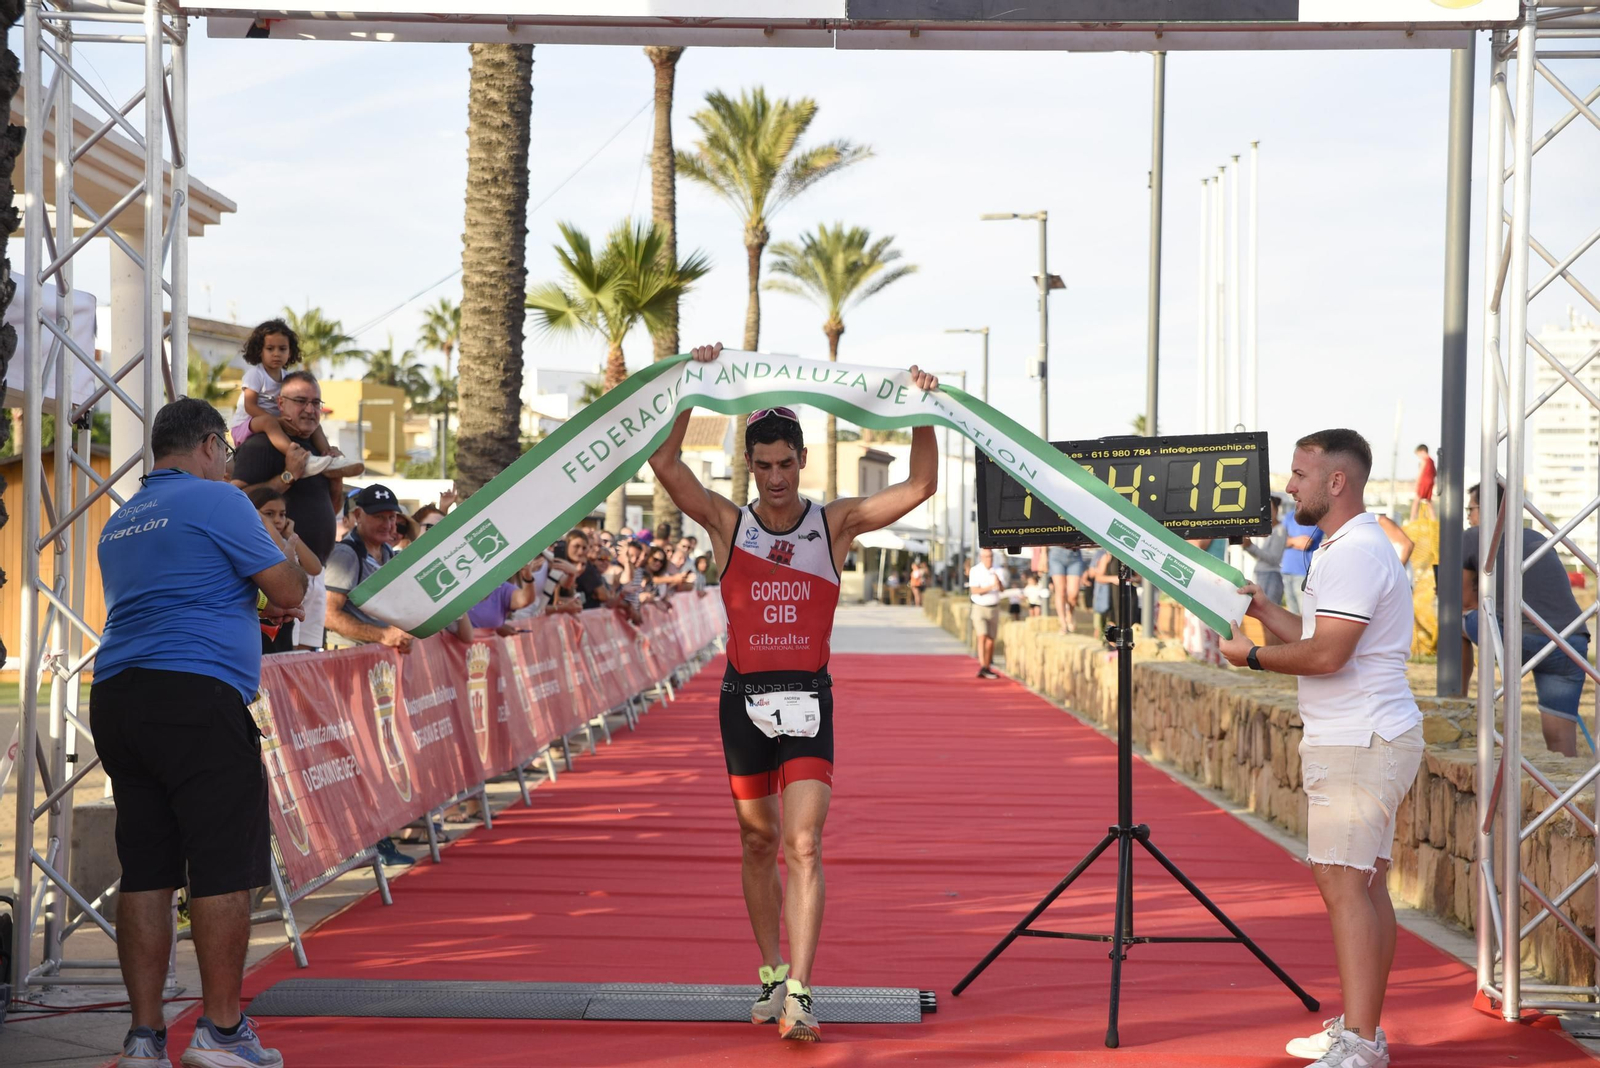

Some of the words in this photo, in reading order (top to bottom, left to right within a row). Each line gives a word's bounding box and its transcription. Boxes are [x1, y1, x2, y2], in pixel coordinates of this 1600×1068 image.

[715, 362, 868, 393] ANDALUZA
[877, 378, 909, 404] DE
[921, 391, 1037, 480] IATLON
[1091, 451, 1110, 459] 615
[1112, 450, 1131, 458] 980
[1133, 448, 1151, 456] 784
[1159, 443, 1257, 454] info@gesconchip.es
[117, 499, 158, 519] OFICIAL
[98, 518, 169, 544] riatlón
[1163, 517, 1260, 528] info@gesconchip.es
[751, 580, 811, 601] GORDON
[763, 604, 798, 624] GIB
[749, 633, 810, 646] Gibraltar
[770, 709, 782, 726] 1
